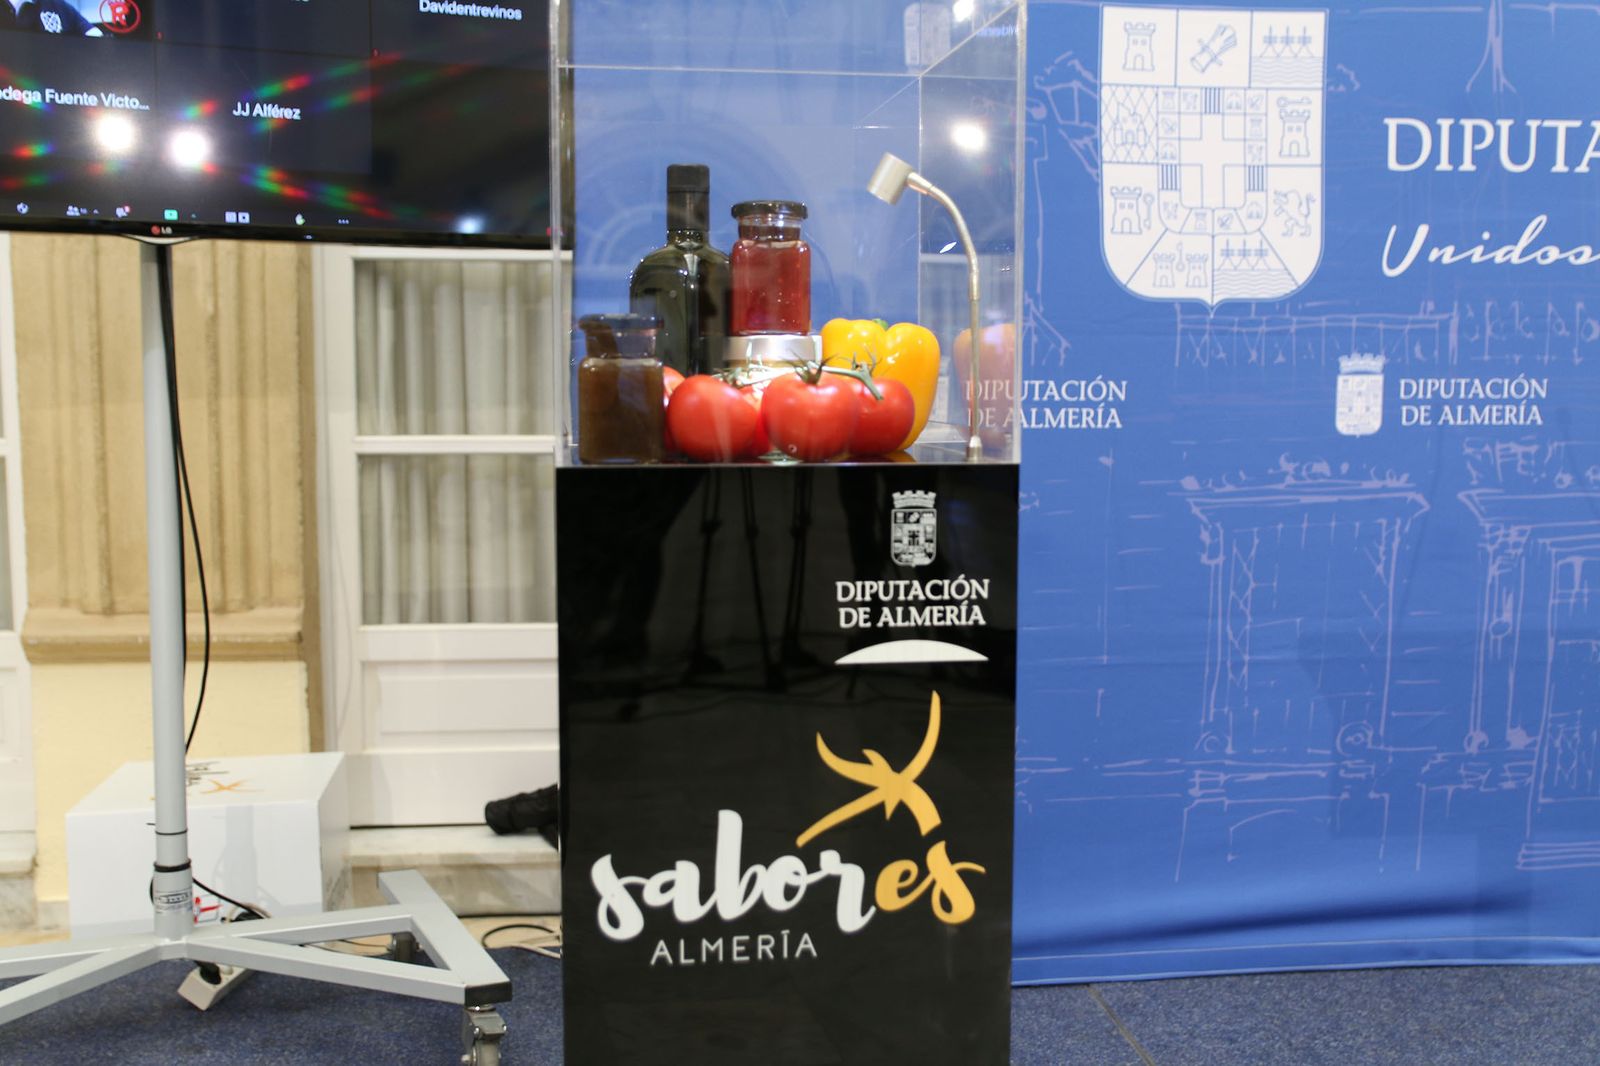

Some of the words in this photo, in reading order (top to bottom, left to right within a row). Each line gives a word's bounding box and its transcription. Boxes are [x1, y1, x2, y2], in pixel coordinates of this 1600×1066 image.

[419, 0, 522, 20] Davidentrevinos
[0, 85, 42, 104] dega
[45, 88, 98, 106] Fuente
[232, 101, 250, 117] JJ
[252, 102, 301, 120] Alférez
[1383, 117, 1600, 173] DIPUTA
[1381, 214, 1600, 277] Unidos
[965, 375, 1127, 401] DIPUTACIÓN
[1399, 373, 1548, 399] DIPUTACIÓN
[1002, 402, 1123, 429] ALMERÍA
[1401, 405, 1431, 426] DE
[1437, 400, 1544, 426] ALMERÍA
[835, 574, 990, 602] DIPUTACIÓN
[838, 607, 872, 628] DE
[876, 600, 986, 628] ALMERÍA
[591, 810, 986, 941] sabores
